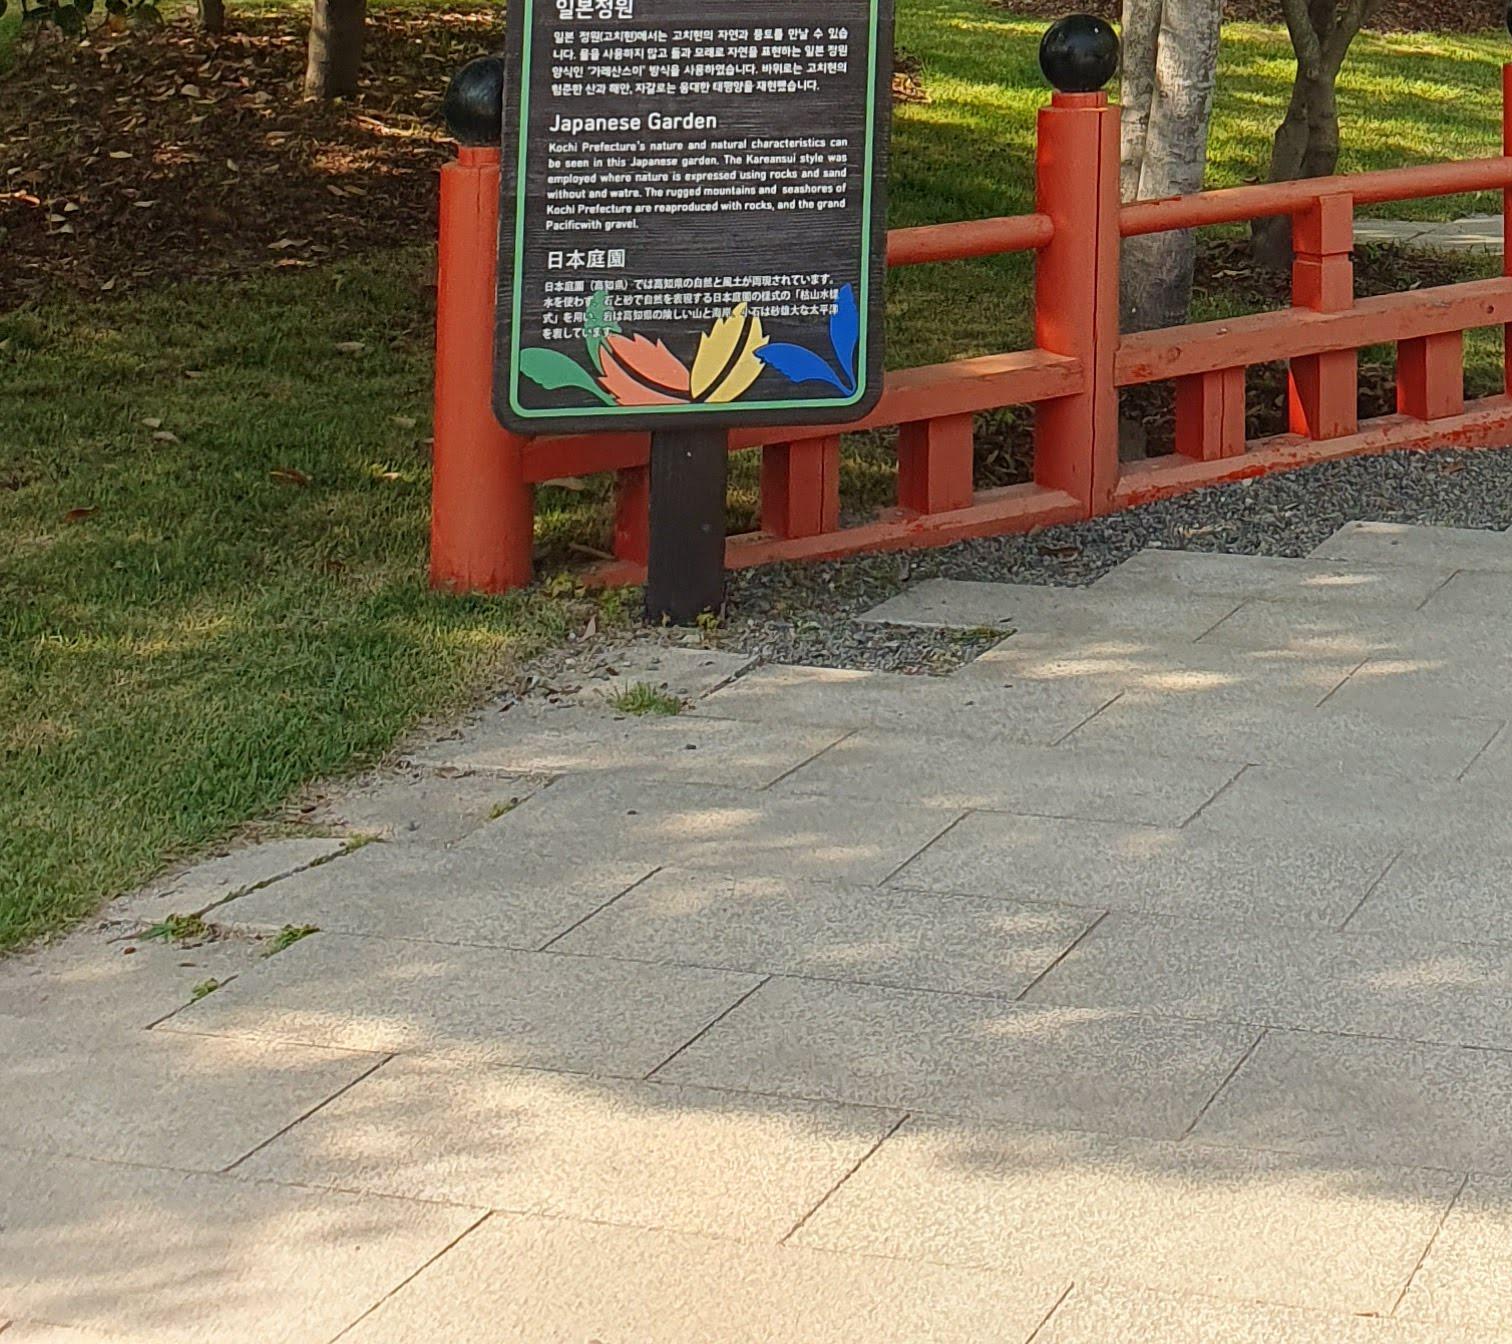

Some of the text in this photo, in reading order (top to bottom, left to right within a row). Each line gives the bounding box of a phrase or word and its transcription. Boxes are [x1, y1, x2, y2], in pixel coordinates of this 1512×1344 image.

[553, 31, 574, 44] 일본
[672, 29, 714, 42] 고치현의
[717, 29, 748, 41] 자연과
[787, 28, 809, 40] 만날
[813, 27, 823, 39] 수
[828, 27, 848, 39] 있습
[552, 48, 576, 60] 니다.
[602, 47, 644, 60] 사용하지
[693, 46, 725, 58] 모래로
[727, 45, 758, 58] 자연을
[761, 45, 802, 58] 표현하는
[804, 44, 824, 57] 일본
[827, 44, 848, 57] 정원
[552, 65, 584, 78] 양식인
[648, 64, 680, 77] 방식을
[761, 62, 803, 75] 바위로는
[806, 62, 847, 74] 고치현의
[585, 83, 606, 95] 산과
[608, 83, 633, 95] 해안,
[635, 81, 676, 94] 자갈로는
[549, 111, 717, 135] Japanese Garden
[548, 137, 848, 152] Kochi Prefecture's nature and natural characteristics can
[548, 158, 561, 168] be
[564, 159, 589, 168] seen
[593, 157, 603, 167] in
[606, 157, 626, 167] this
[630, 157, 678, 167] Japanese
[681, 155, 719, 167] garden.
[723, 154, 742, 164] The
[799, 152, 824, 164] style
[827, 154, 847, 162] was
[547, 167, 847, 185] employed where nature is expressed using rocks and sand
[546, 188, 586, 199] without
[588, 188, 608, 198] and
[644, 186, 664, 197] The
[665, 186, 701, 198] rugged
[703, 185, 756, 195] mountains
[758, 184, 777, 194] and
[782, 184, 833, 194] seashores
[835, 182, 846, 193] of
[546, 204, 575, 214] Kochi
[577, 203, 632, 214] Prefecture
[634, 205, 652, 213] are
[720, 200, 742, 210] with
[744, 200, 775, 211] rocks,
[777, 199, 796, 209] and
[798, 199, 814, 209] the
[816, 198, 846, 210] grand
[604, 218, 638, 231] gravel.
[547, 249, 626, 269] 日本庭園
